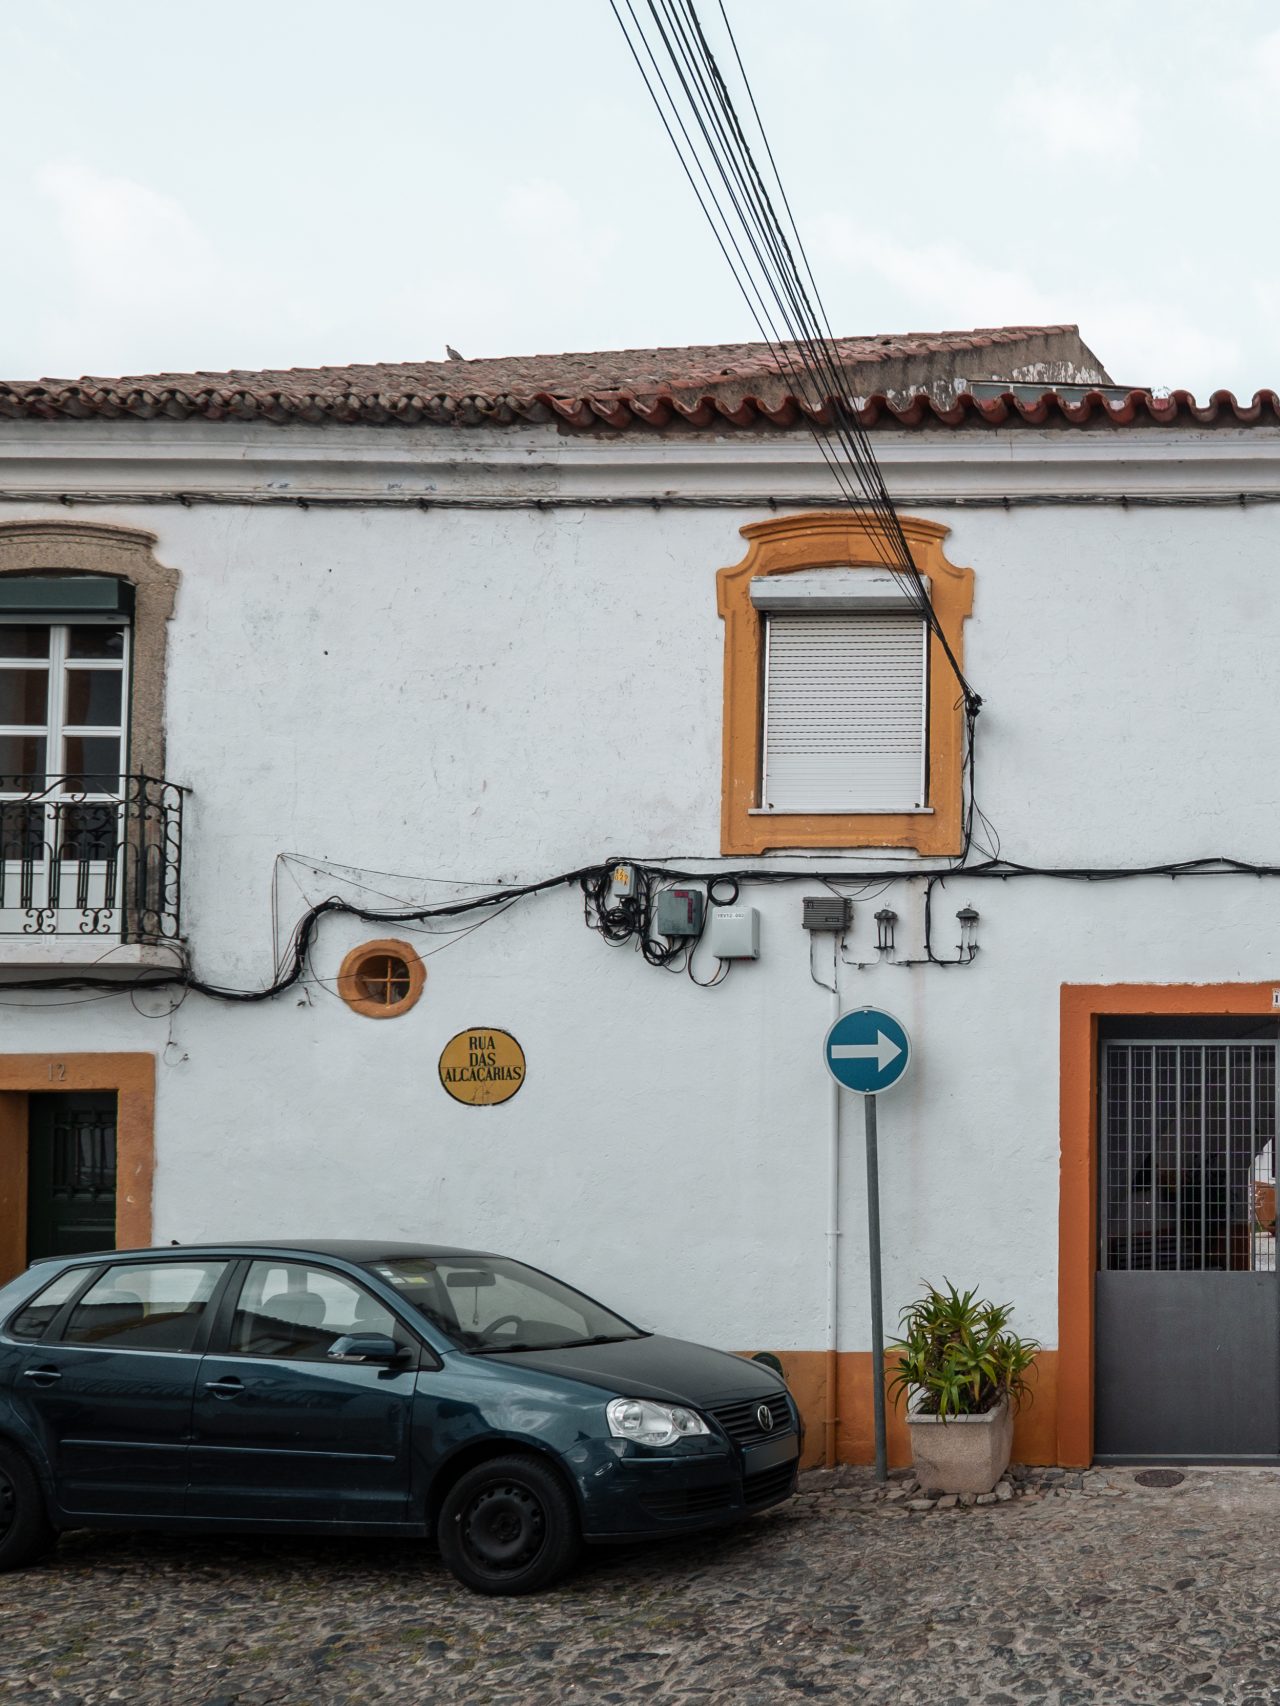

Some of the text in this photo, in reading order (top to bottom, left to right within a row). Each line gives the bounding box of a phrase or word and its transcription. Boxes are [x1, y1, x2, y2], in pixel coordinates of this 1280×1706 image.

[469, 1036, 496, 1050] RUA
[470, 1053, 496, 1067] DAS
[48, 1063, 66, 1081] 12
